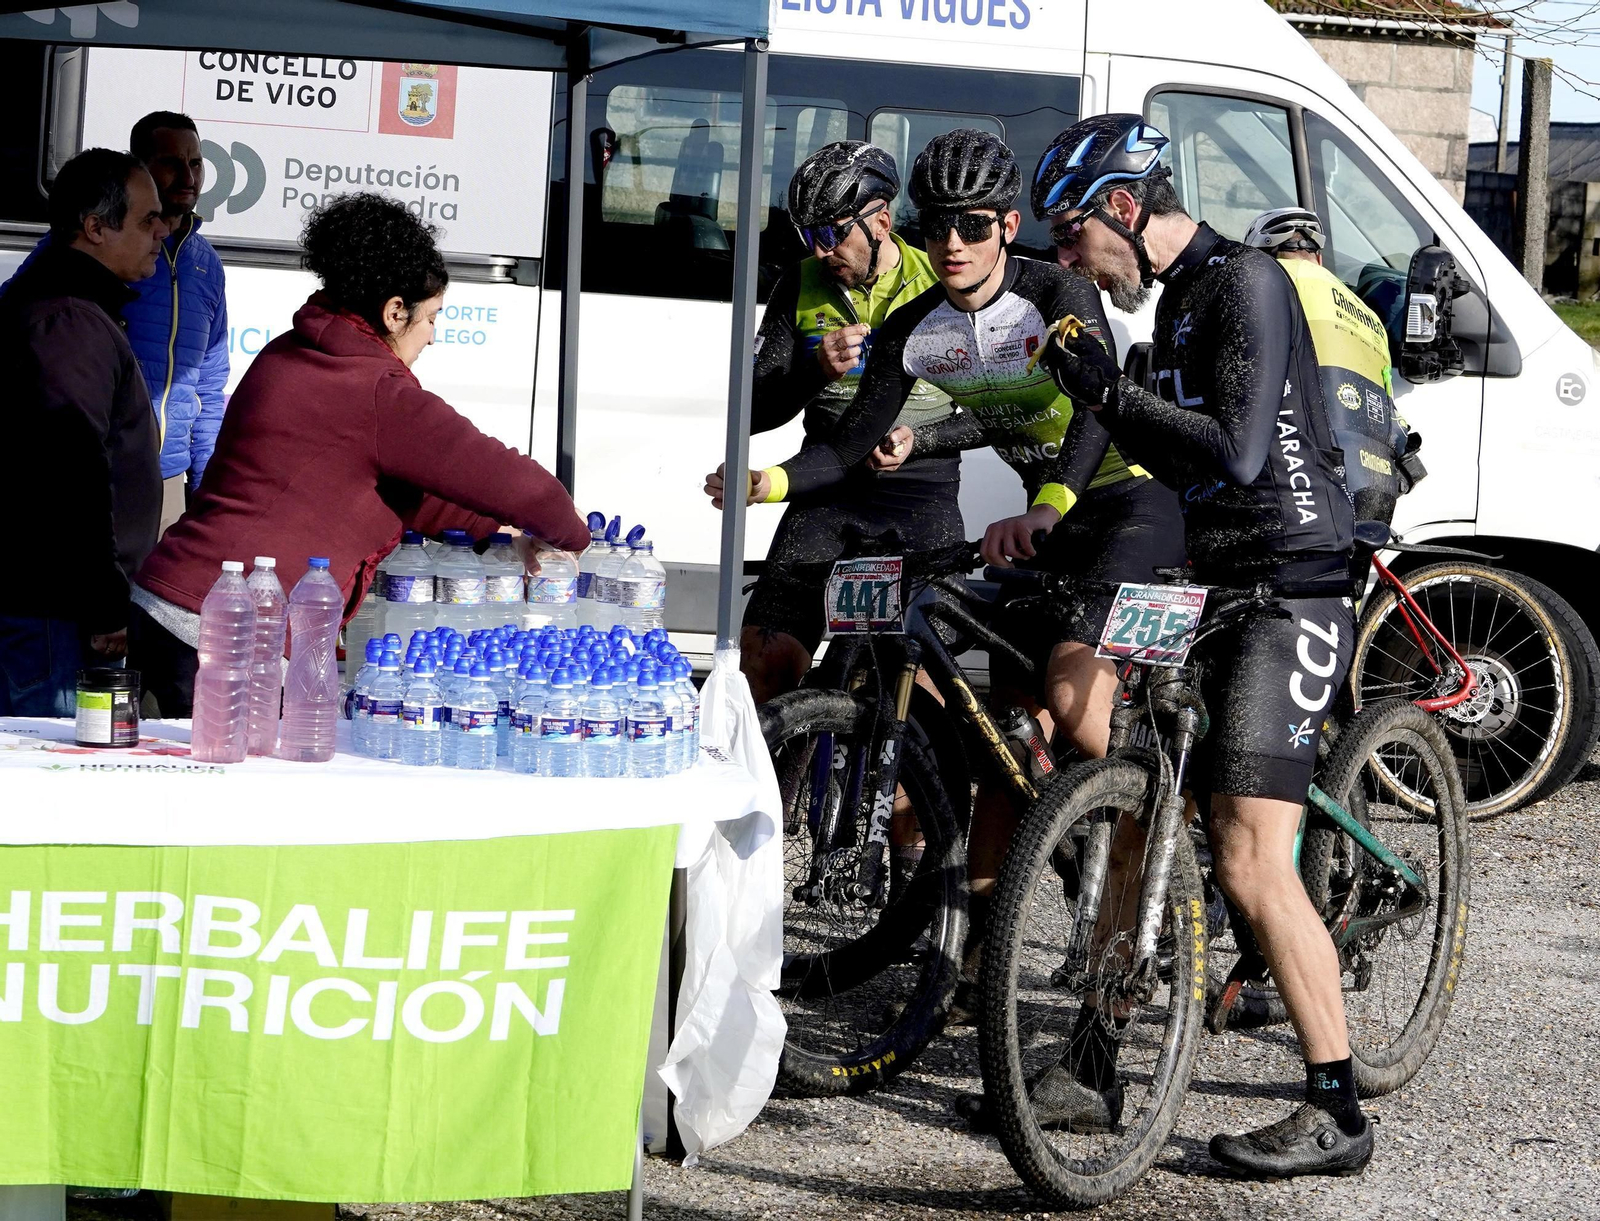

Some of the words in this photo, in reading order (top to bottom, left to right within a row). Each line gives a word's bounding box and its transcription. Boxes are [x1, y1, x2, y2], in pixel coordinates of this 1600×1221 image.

[199, 51, 357, 81] CONCELLO
[216, 79, 254, 103] DE
[265, 82, 337, 109] VIGO
[284, 157, 460, 192] Deputación
[282, 186, 458, 221] Pondra
[439, 305, 498, 323] ORTE
[1559, 377, 1582, 401] EC
[976, 403, 1024, 418] XUNTA
[1001, 407, 1062, 430] GALICIA
[998, 437, 1065, 464] BANC
[1276, 409, 1319, 525] LARACHA
[836, 580, 890, 619] 447
[1110, 605, 1190, 650] 255
[866, 789, 896, 844] FOX
[1190, 900, 1205, 1001] MAXXIS
[830, 1050, 897, 1077] MAXXIS
